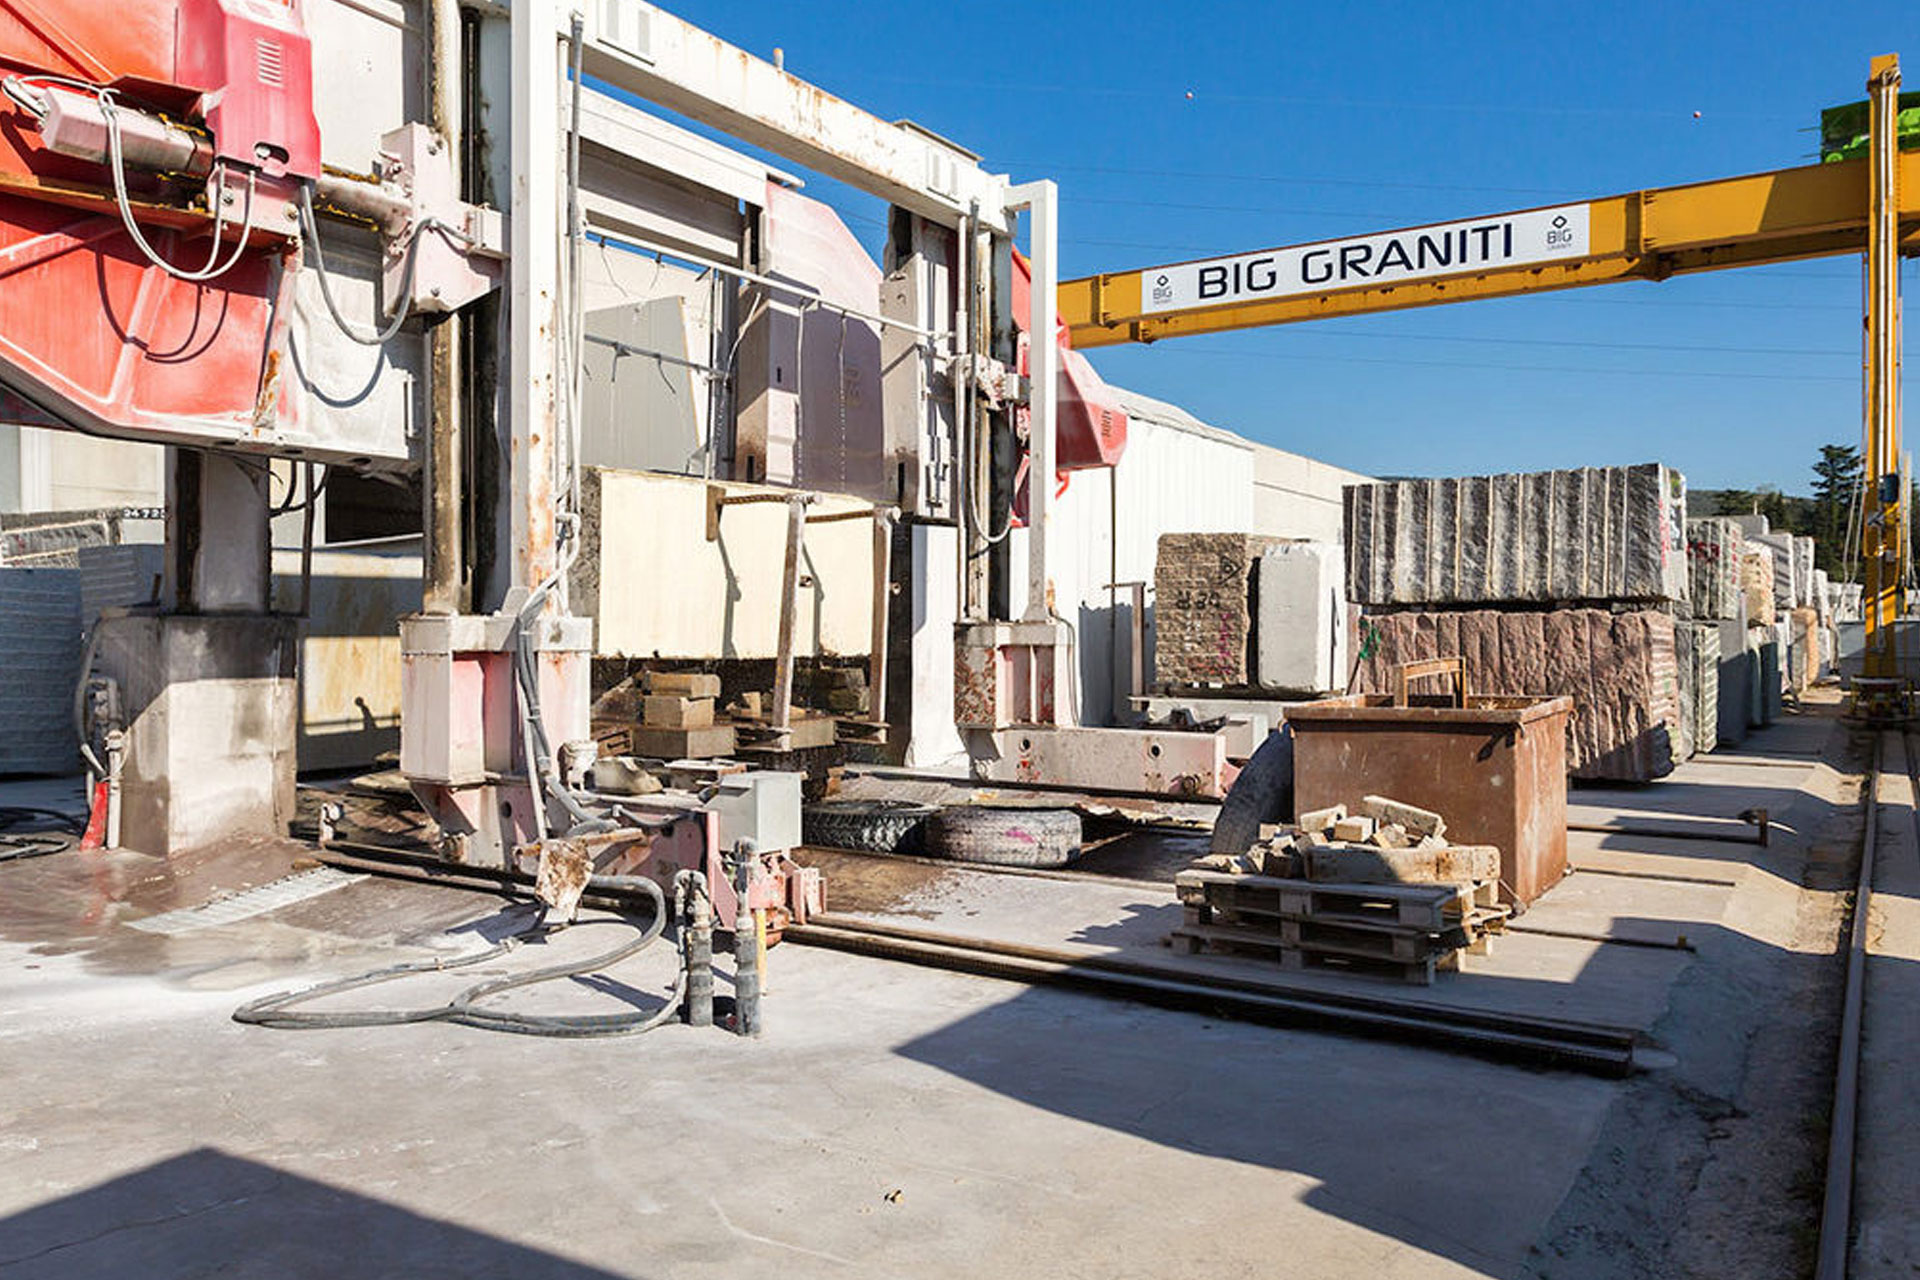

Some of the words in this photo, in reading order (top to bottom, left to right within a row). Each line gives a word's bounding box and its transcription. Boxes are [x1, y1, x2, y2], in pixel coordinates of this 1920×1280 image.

[1547, 229, 1572, 244] BIG
[1199, 258, 1277, 299] BIG
[1302, 222, 1513, 284] GRANITI
[1153, 286, 1173, 299] BIG
